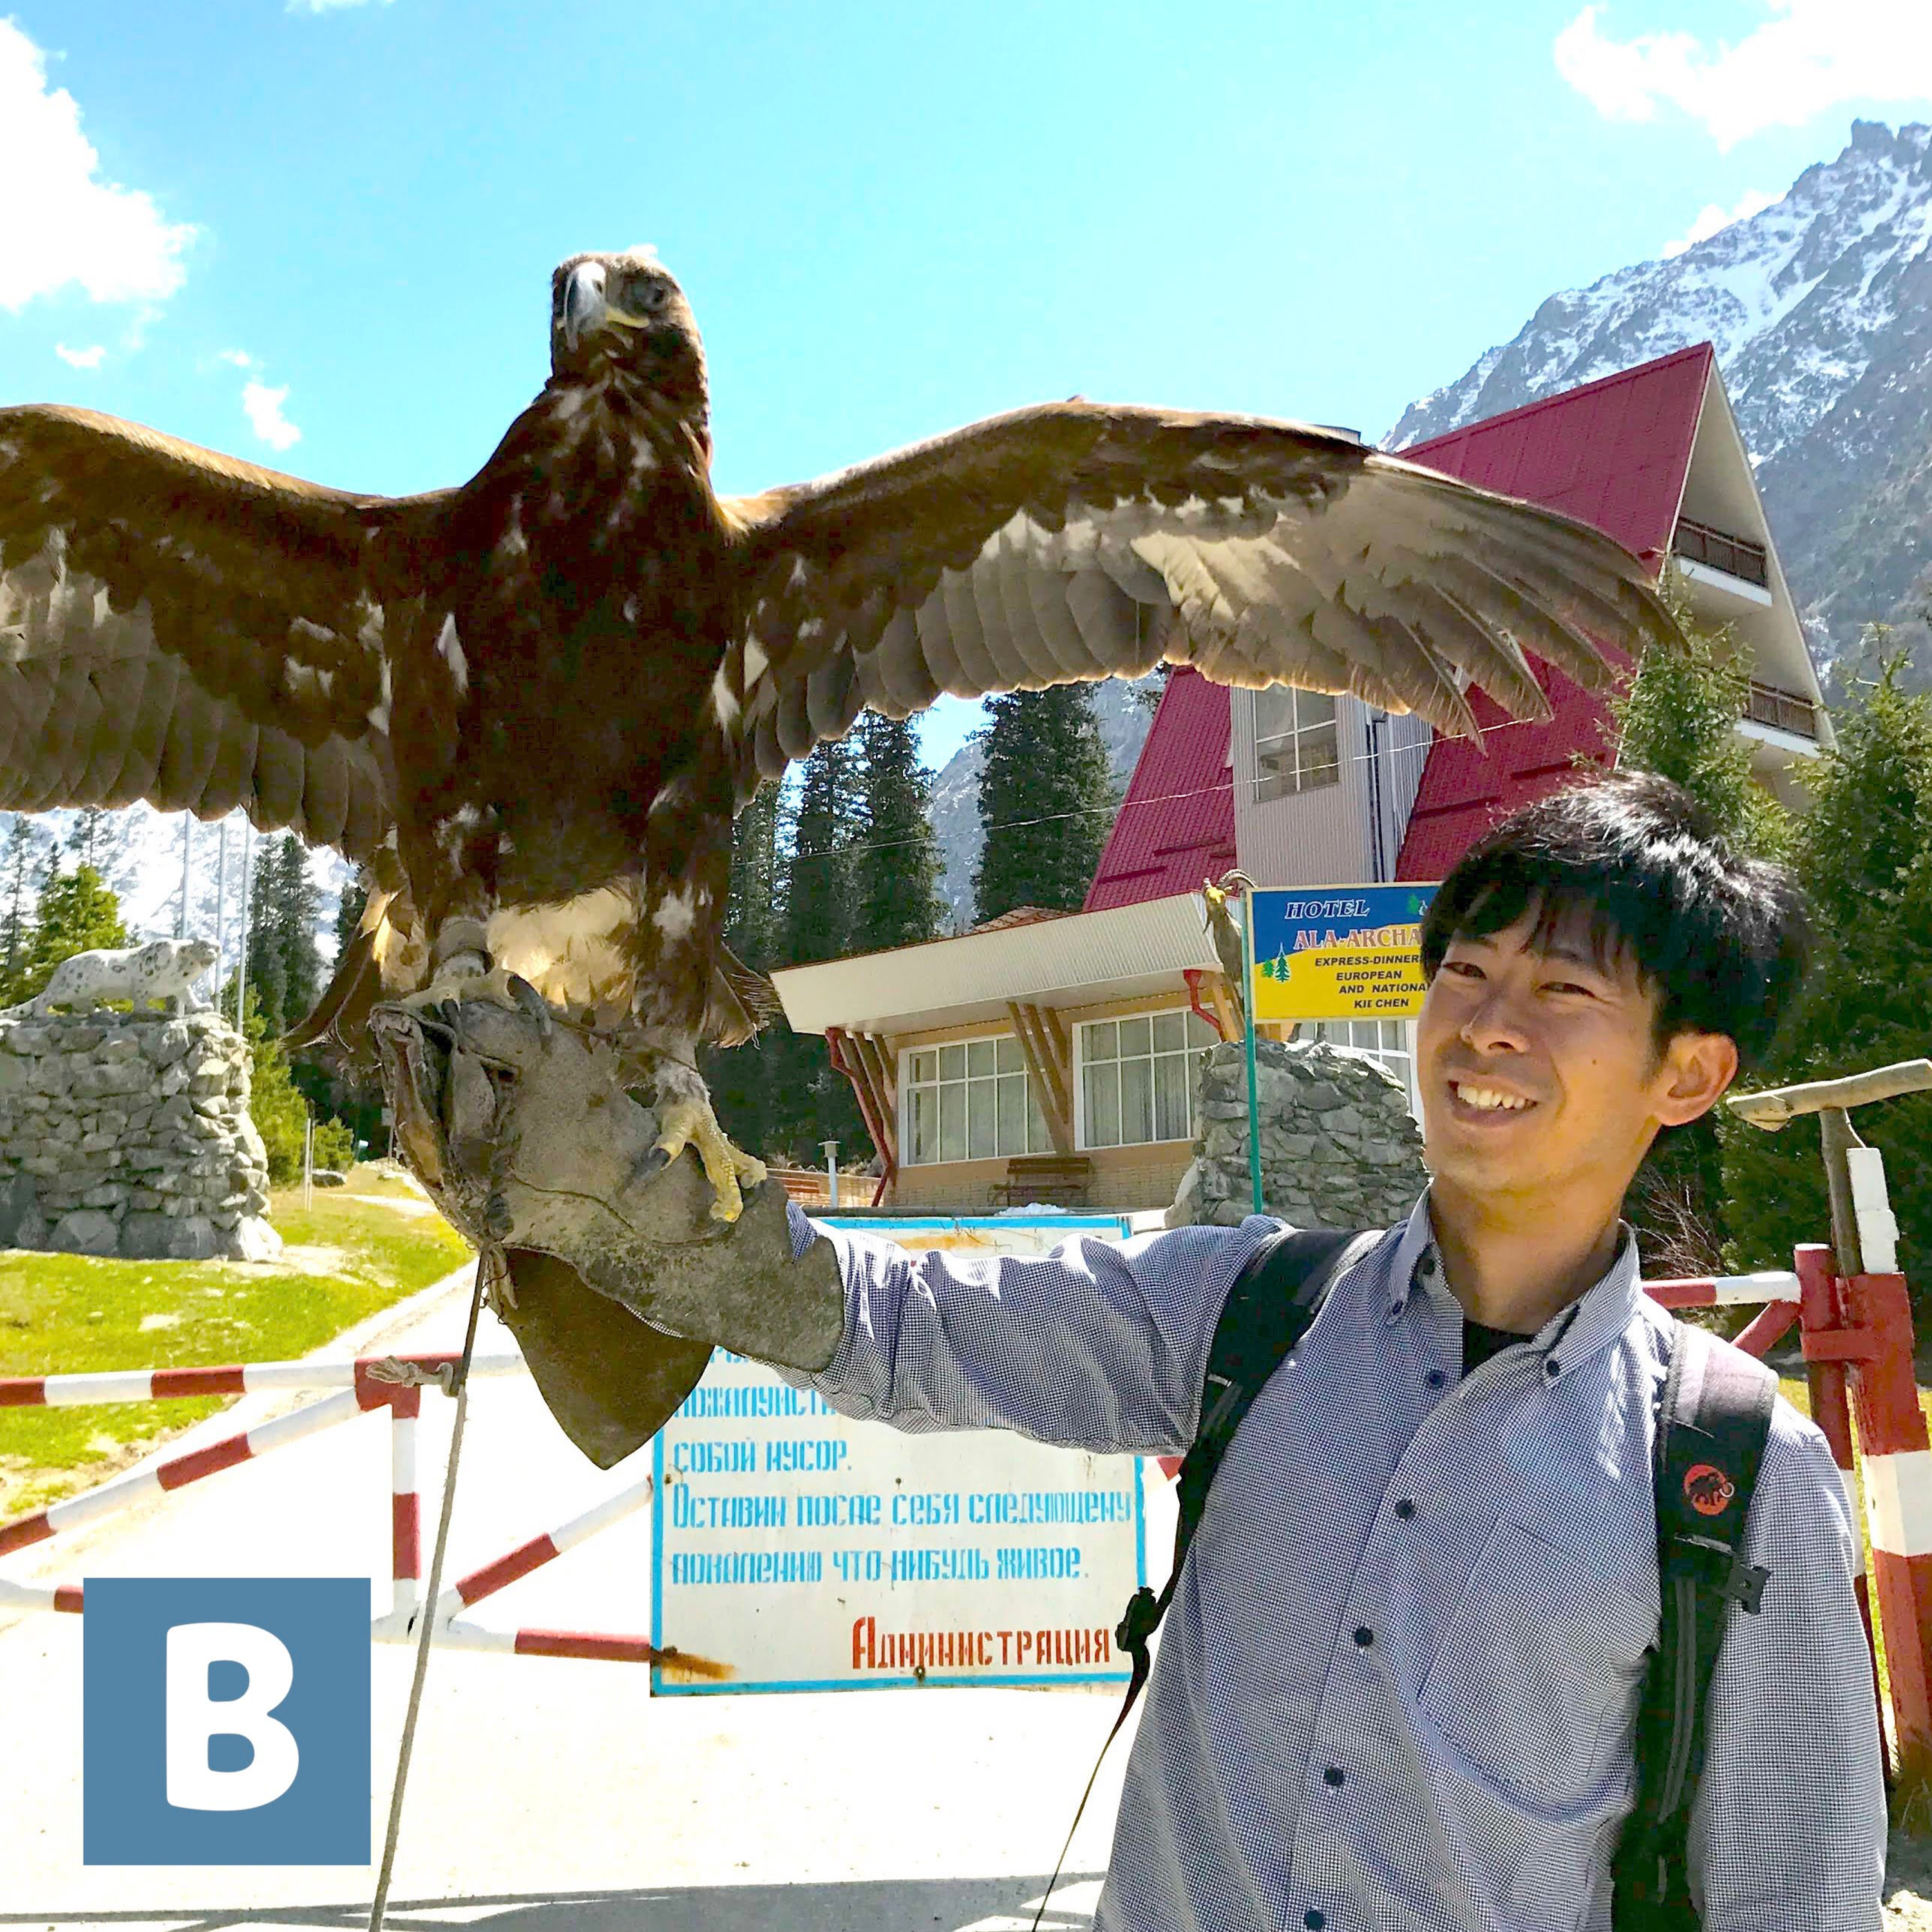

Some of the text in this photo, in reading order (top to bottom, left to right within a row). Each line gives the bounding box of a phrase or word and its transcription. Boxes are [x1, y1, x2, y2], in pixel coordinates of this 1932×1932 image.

[1285, 900, 1370, 919] HOTEL
[1293, 927, 1423, 950] ALA-ARCHA
[1336, 971, 1402, 980] EUROPEAN
[1339, 985, 1365, 994] AND
